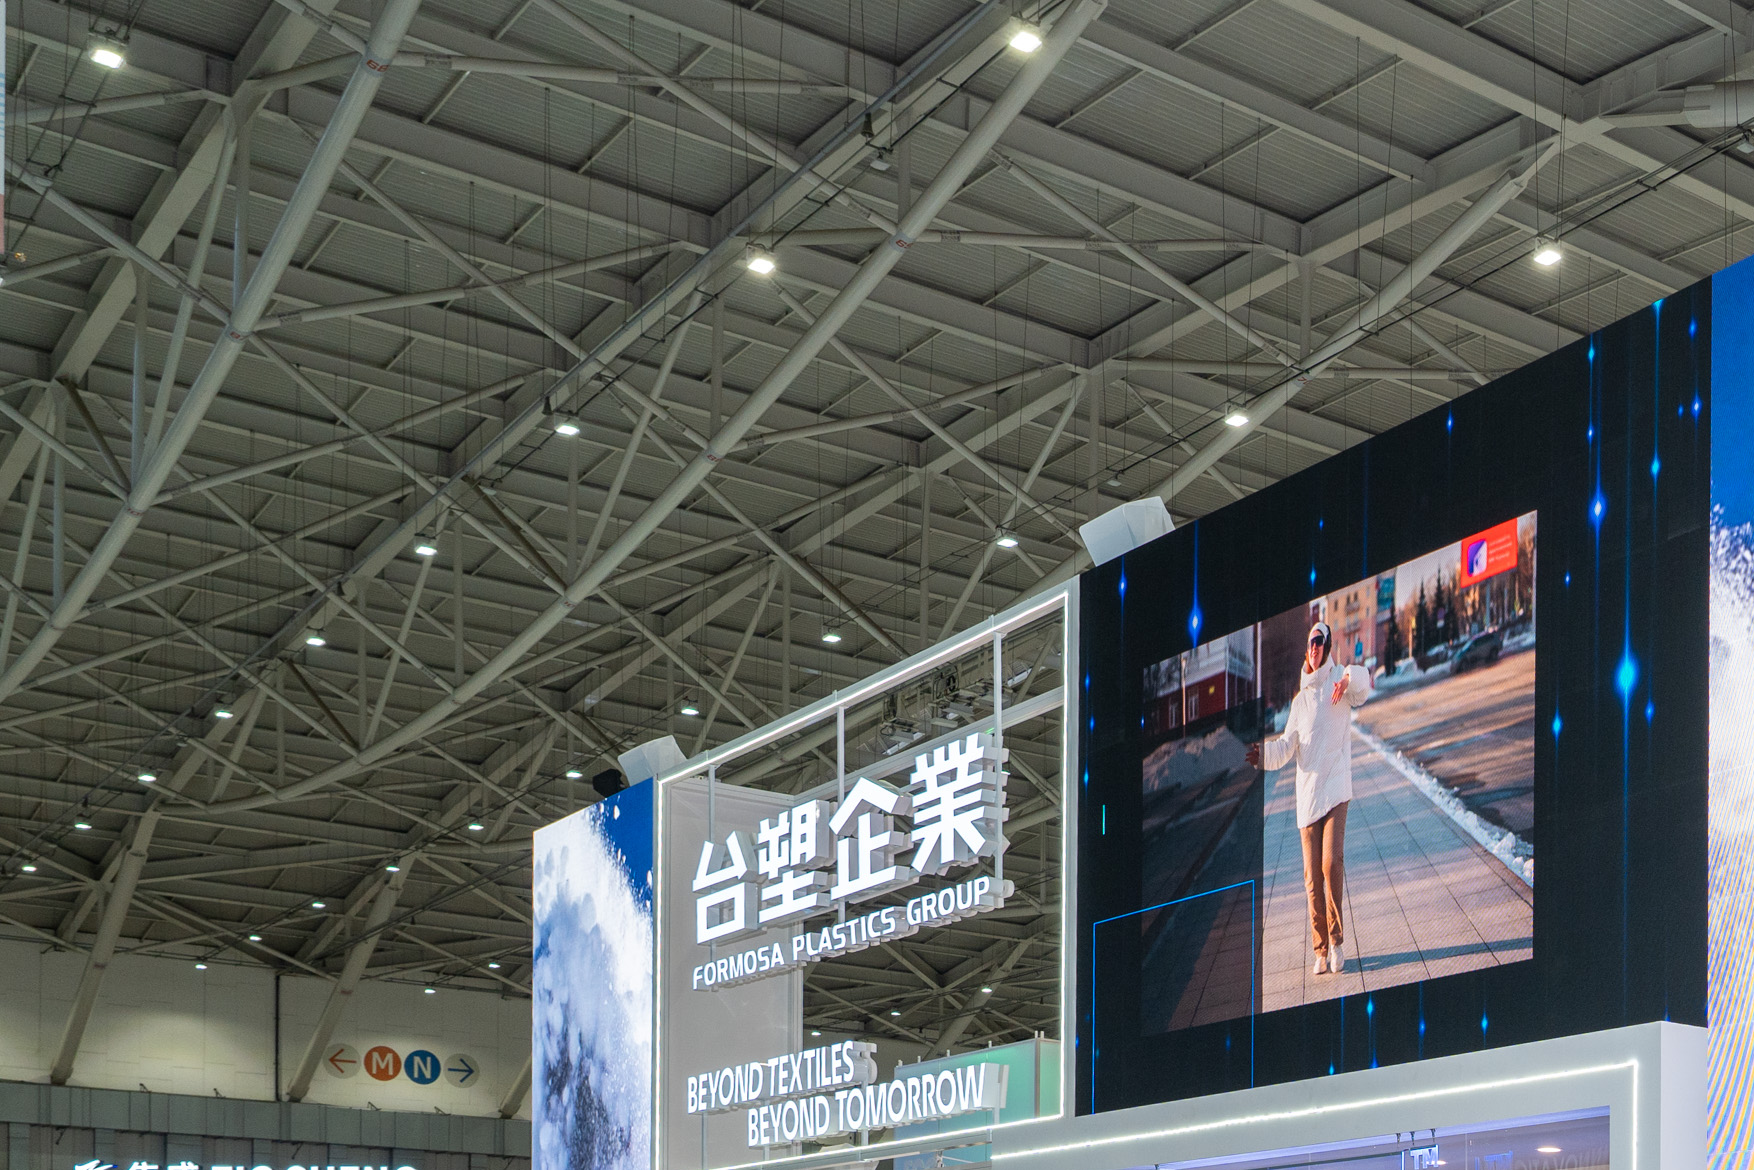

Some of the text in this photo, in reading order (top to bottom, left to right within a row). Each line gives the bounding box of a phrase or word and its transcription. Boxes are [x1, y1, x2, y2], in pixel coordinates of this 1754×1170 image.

[692, 733, 987, 945] 台塑企業
[692, 876, 991, 991] FORMOSA PLASTICS GROUP
[371, 1051, 432, 1079] M N
[687, 1040, 855, 1114] BEYOND TEXTILES
[747, 1062, 987, 1147] BEYOND TOMORROW
